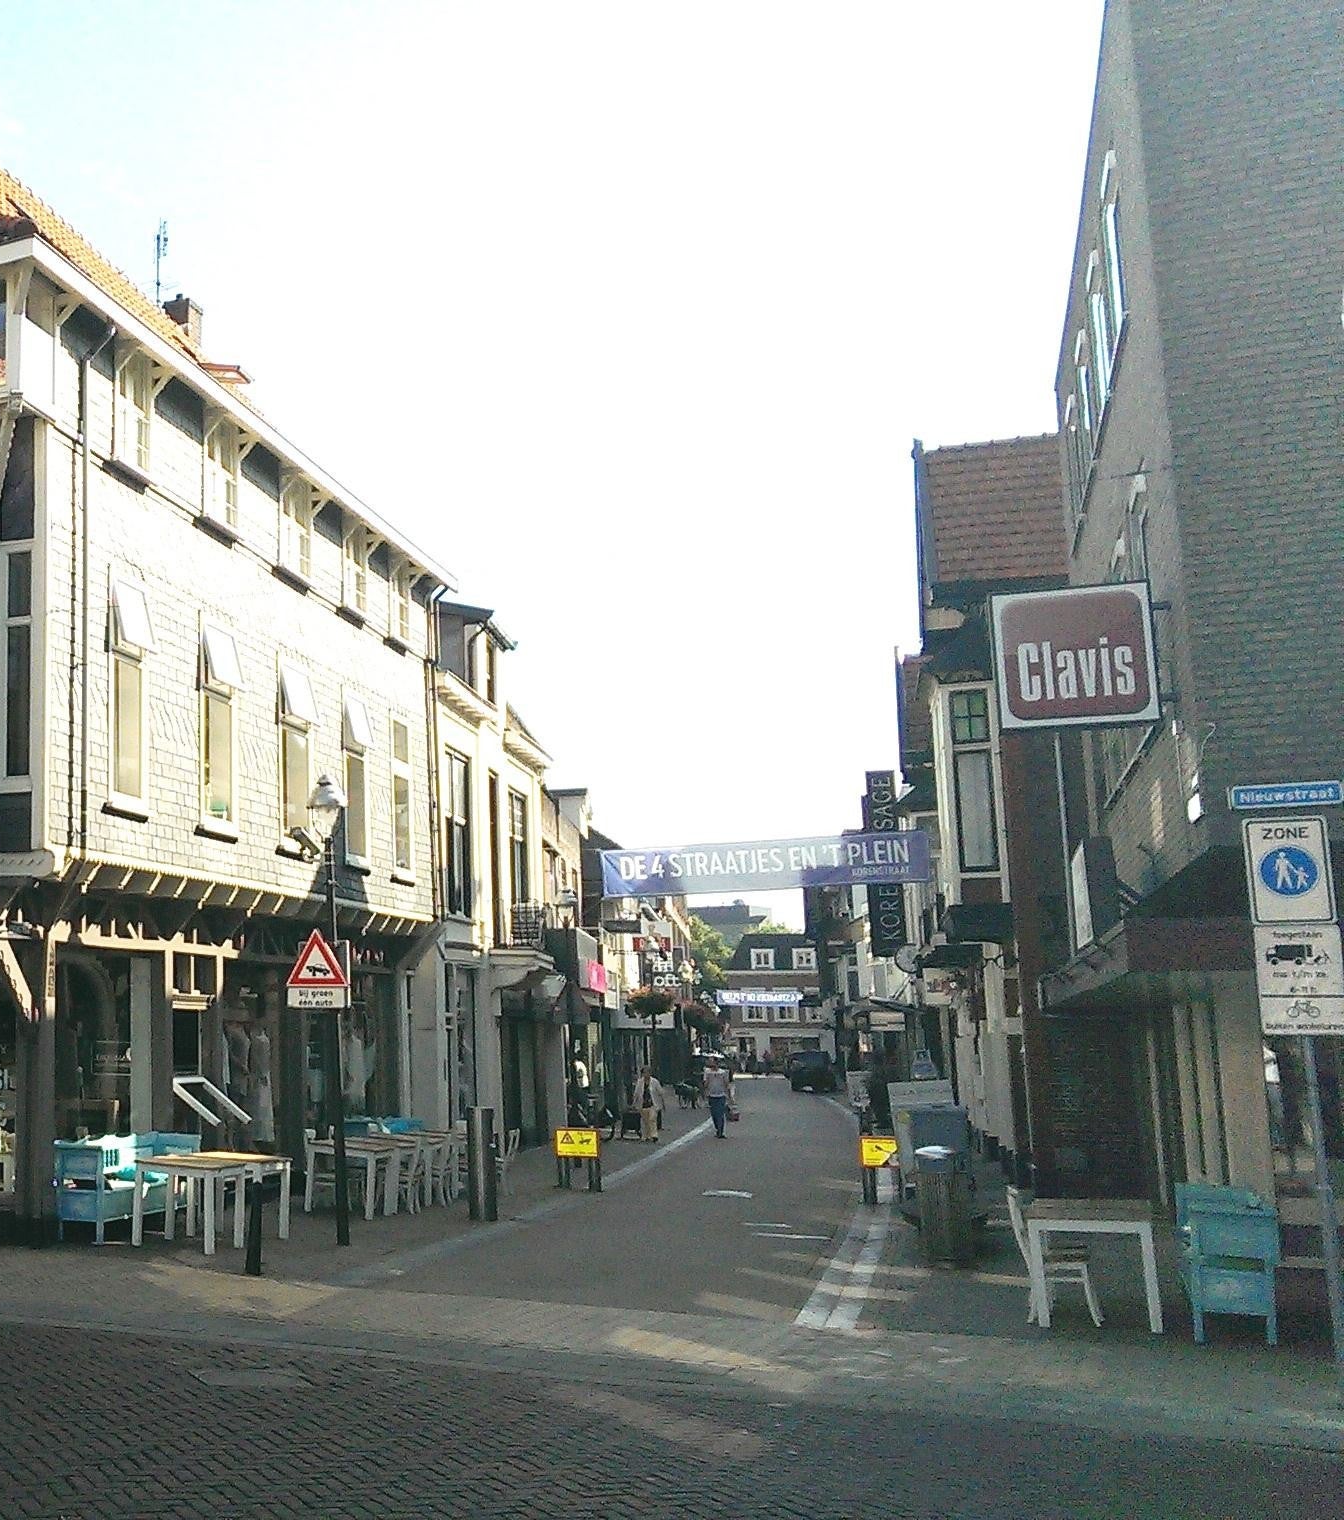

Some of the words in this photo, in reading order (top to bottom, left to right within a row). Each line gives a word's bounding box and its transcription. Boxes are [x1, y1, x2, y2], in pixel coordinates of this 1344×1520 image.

[1017, 636, 1136, 701] Clavis
[1239, 787, 1335, 803] Nieuwstraat
[1261, 827, 1310, 840] ZONE
[619, 855, 648, 880] DE
[651, 853, 665, 879] 4
[669, 848, 784, 878] STRAATJES
[790, 846, 817, 871] EN
[847, 839, 910, 866] PLEIN
[299, 989, 309, 998] bij
[311, 991, 334, 999] groen
